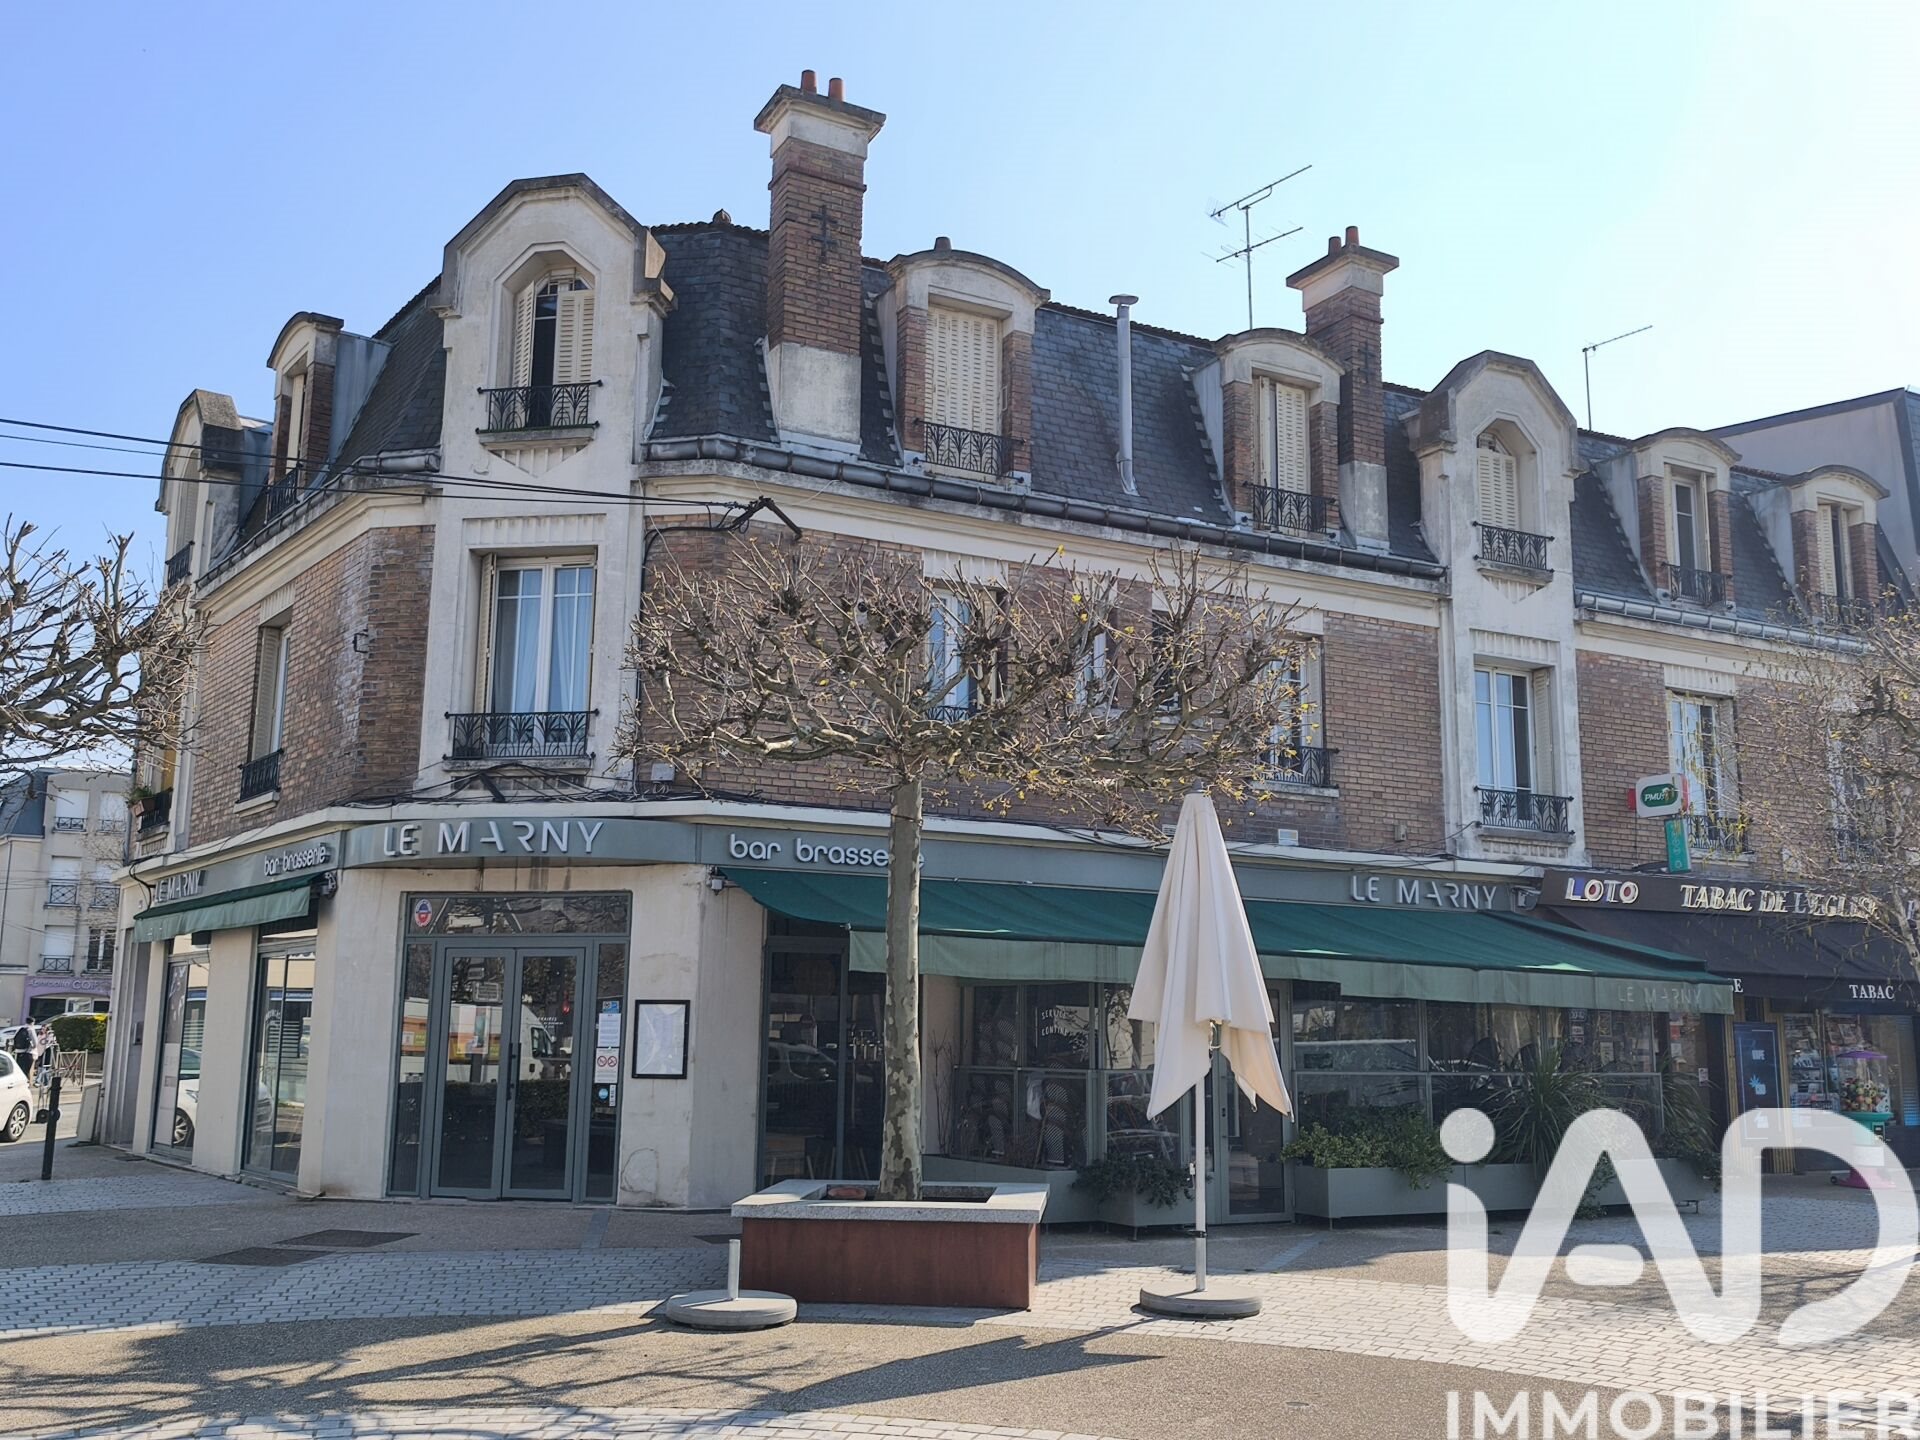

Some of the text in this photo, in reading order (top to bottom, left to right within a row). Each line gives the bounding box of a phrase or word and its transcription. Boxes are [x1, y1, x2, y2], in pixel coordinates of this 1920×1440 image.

[1644, 792, 1663, 802] PMU
[383, 820, 604, 857] LE MARNY
[729, 833, 925, 868] bar brasse
[264, 845, 327, 876] bar brasserie
[154, 870, 202, 903] LE MARNY
[1352, 875, 1497, 910] LE MARNY
[1564, 877, 1640, 904] LOTO
[1680, 884, 1756, 912] TABAC
[1758, 889, 1790, 914] DE
[1617, 986, 1635, 1003] LE
[1849, 984, 1895, 1000] TABAC
